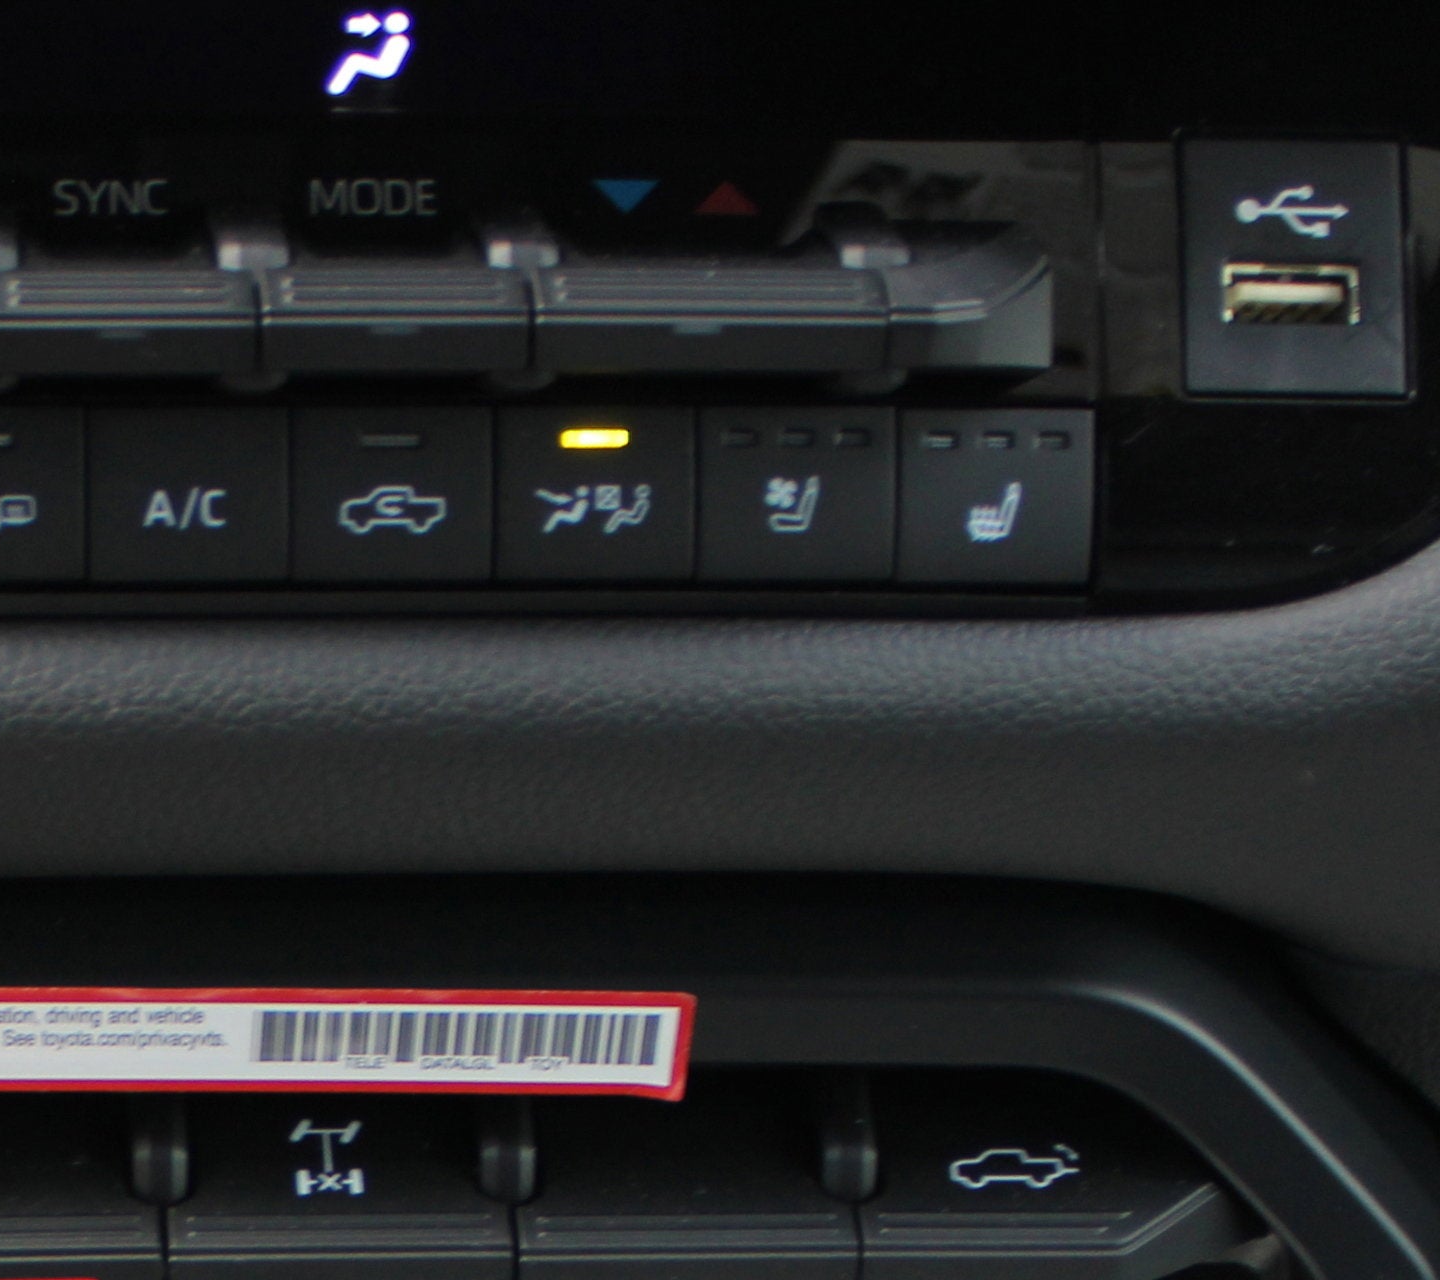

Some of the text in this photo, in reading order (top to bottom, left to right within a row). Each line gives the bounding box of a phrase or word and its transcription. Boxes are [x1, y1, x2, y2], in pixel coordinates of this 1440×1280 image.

[52, 179, 169, 218] SYNC
[309, 178, 437, 218] MODE
[142, 487, 227, 531] A/C
[44, 1007, 102, 1028] driving
[108, 1007, 140, 1024] and
[146, 1007, 205, 1024] vehicle
[2, 1029, 35, 1046] See
